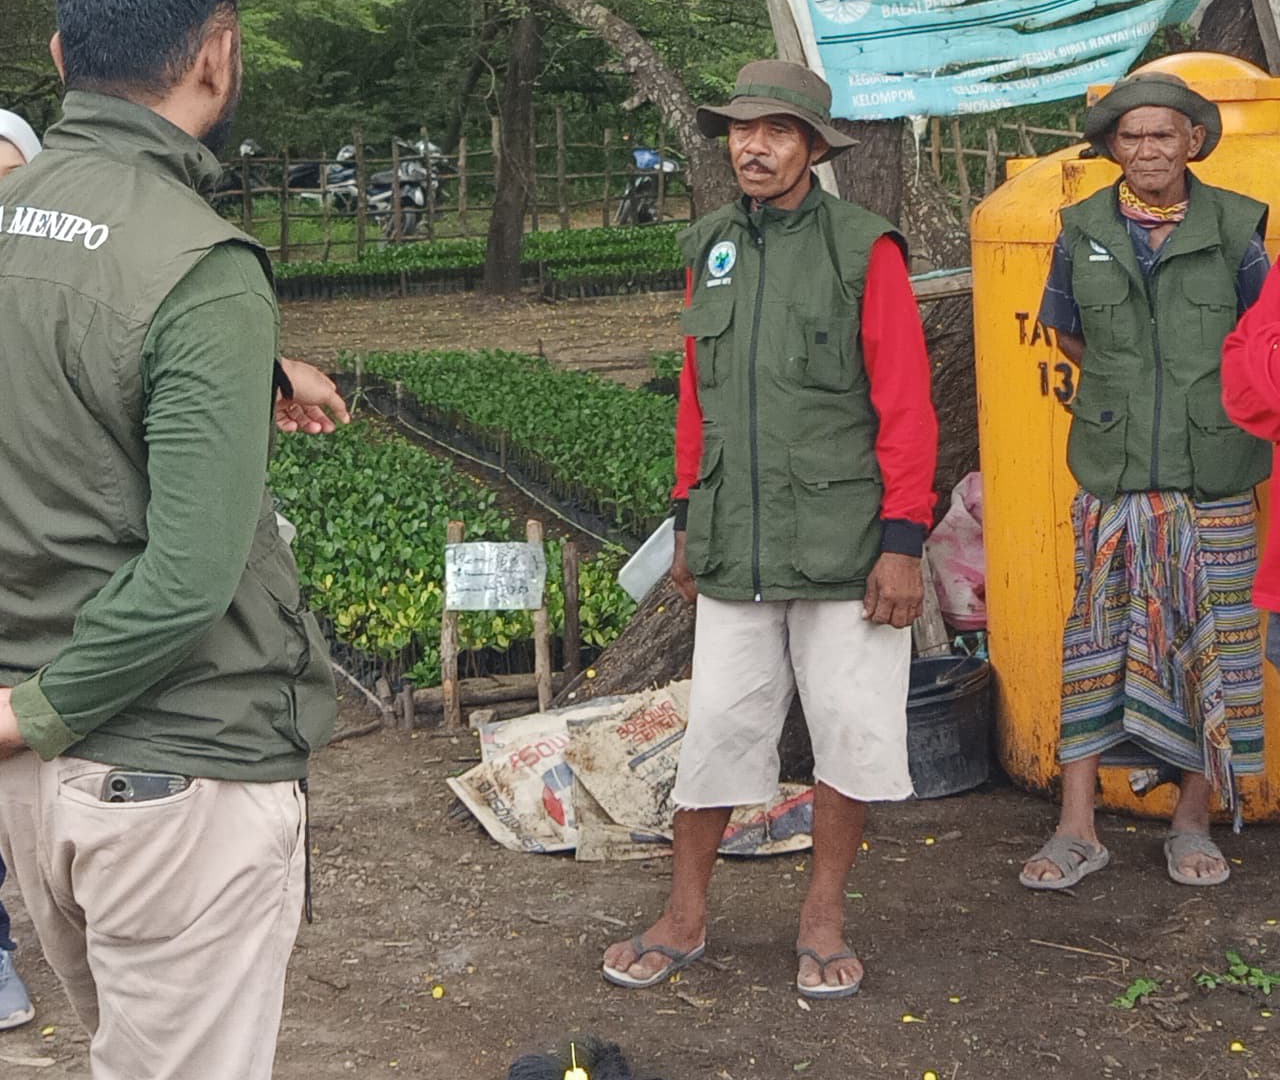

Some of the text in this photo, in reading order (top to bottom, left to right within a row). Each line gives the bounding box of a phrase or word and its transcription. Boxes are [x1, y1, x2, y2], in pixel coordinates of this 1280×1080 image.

[881, 0, 922, 19] BALAI
[851, 88, 916, 108] KELOMPOK
[7, 206, 110, 251] MENIPO
[1038, 361, 1075, 404] 13
